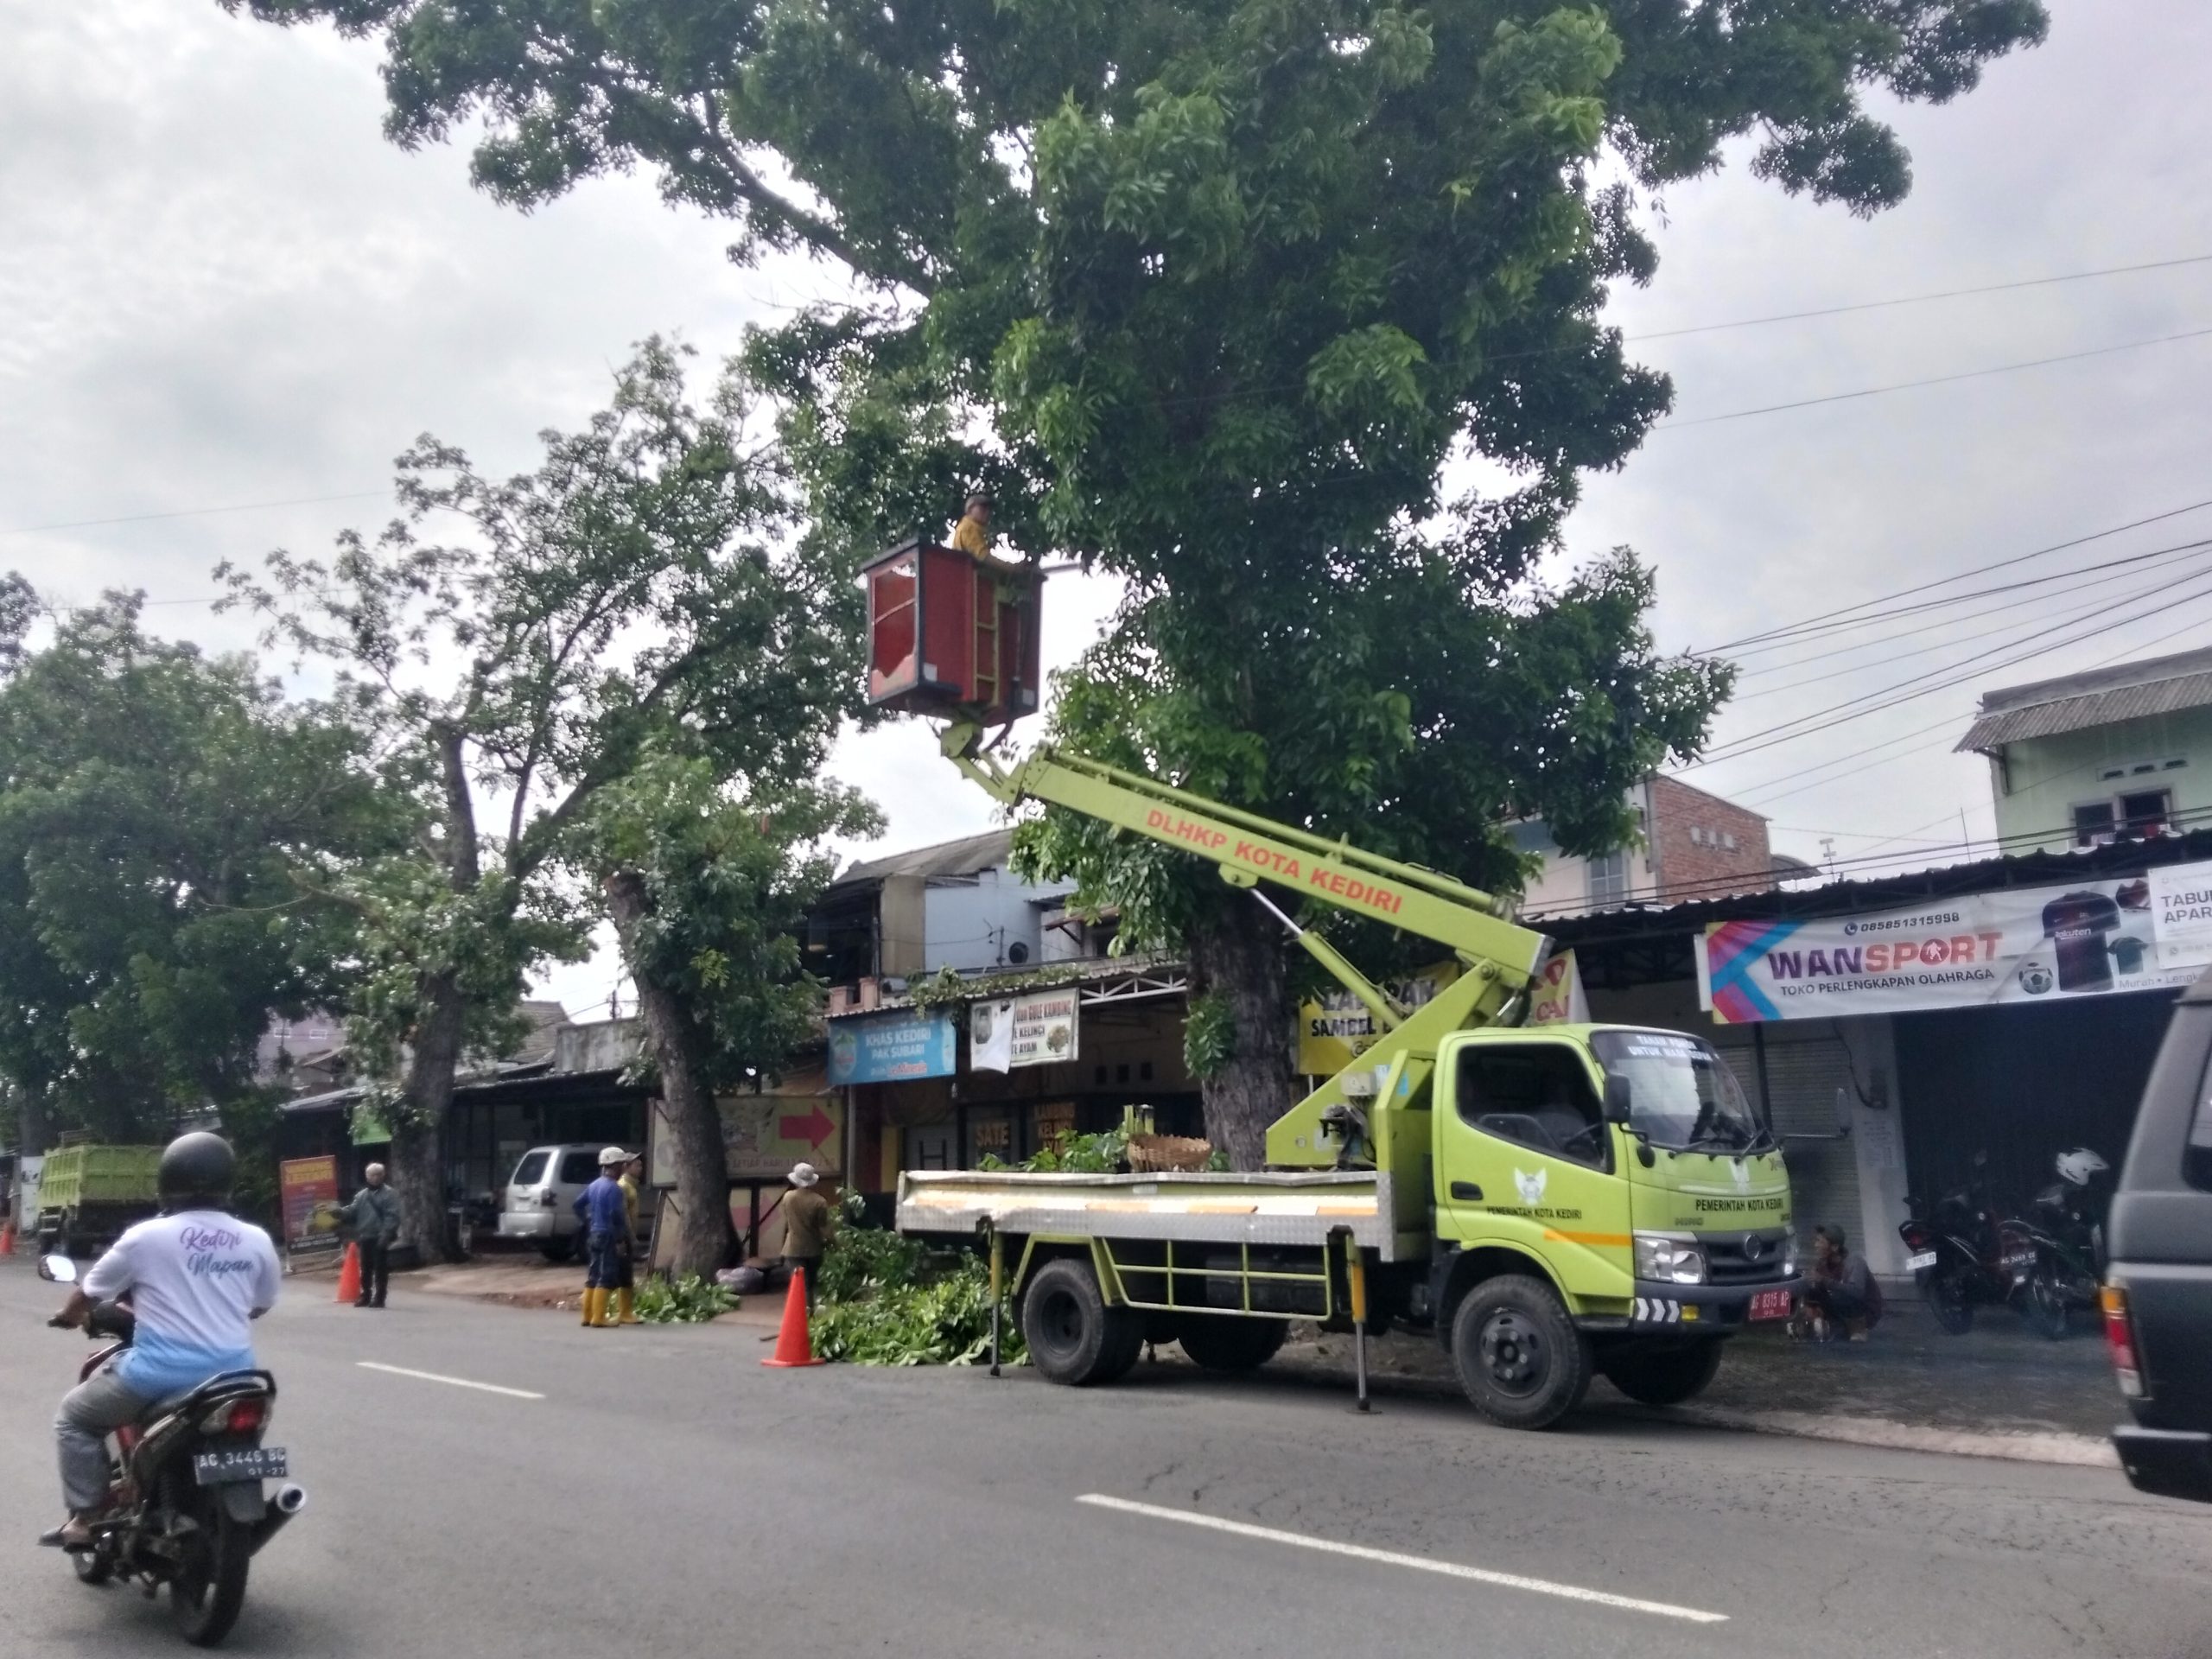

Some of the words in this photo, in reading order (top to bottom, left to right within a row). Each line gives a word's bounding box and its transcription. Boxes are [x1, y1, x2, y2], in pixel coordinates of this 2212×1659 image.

[1147, 810, 1227, 849] DLHKP
[1234, 840, 1300, 878] KOTA
[1310, 868, 1403, 913] KEDIRI
[1781, 984, 1815, 996] TOKO
[1818, 975, 1916, 994] PERLENGKAPAN
[1918, 968, 1995, 984] OLAHRAGA
[2165, 973, 2200, 986] Lengk
[866, 1032, 893, 1047] KHAS
[895, 1027, 931, 1043] KEDIRI
[975, 1122, 1009, 1147] SATE
[1534, 1208, 1554, 1218] KOTA
[1696, 1198, 1745, 1211] PEMERINTAH
[1748, 1199, 1764, 1211] KOTA
[180, 1226, 243, 1252] Kediri
[188, 1252, 254, 1279] Mapan
